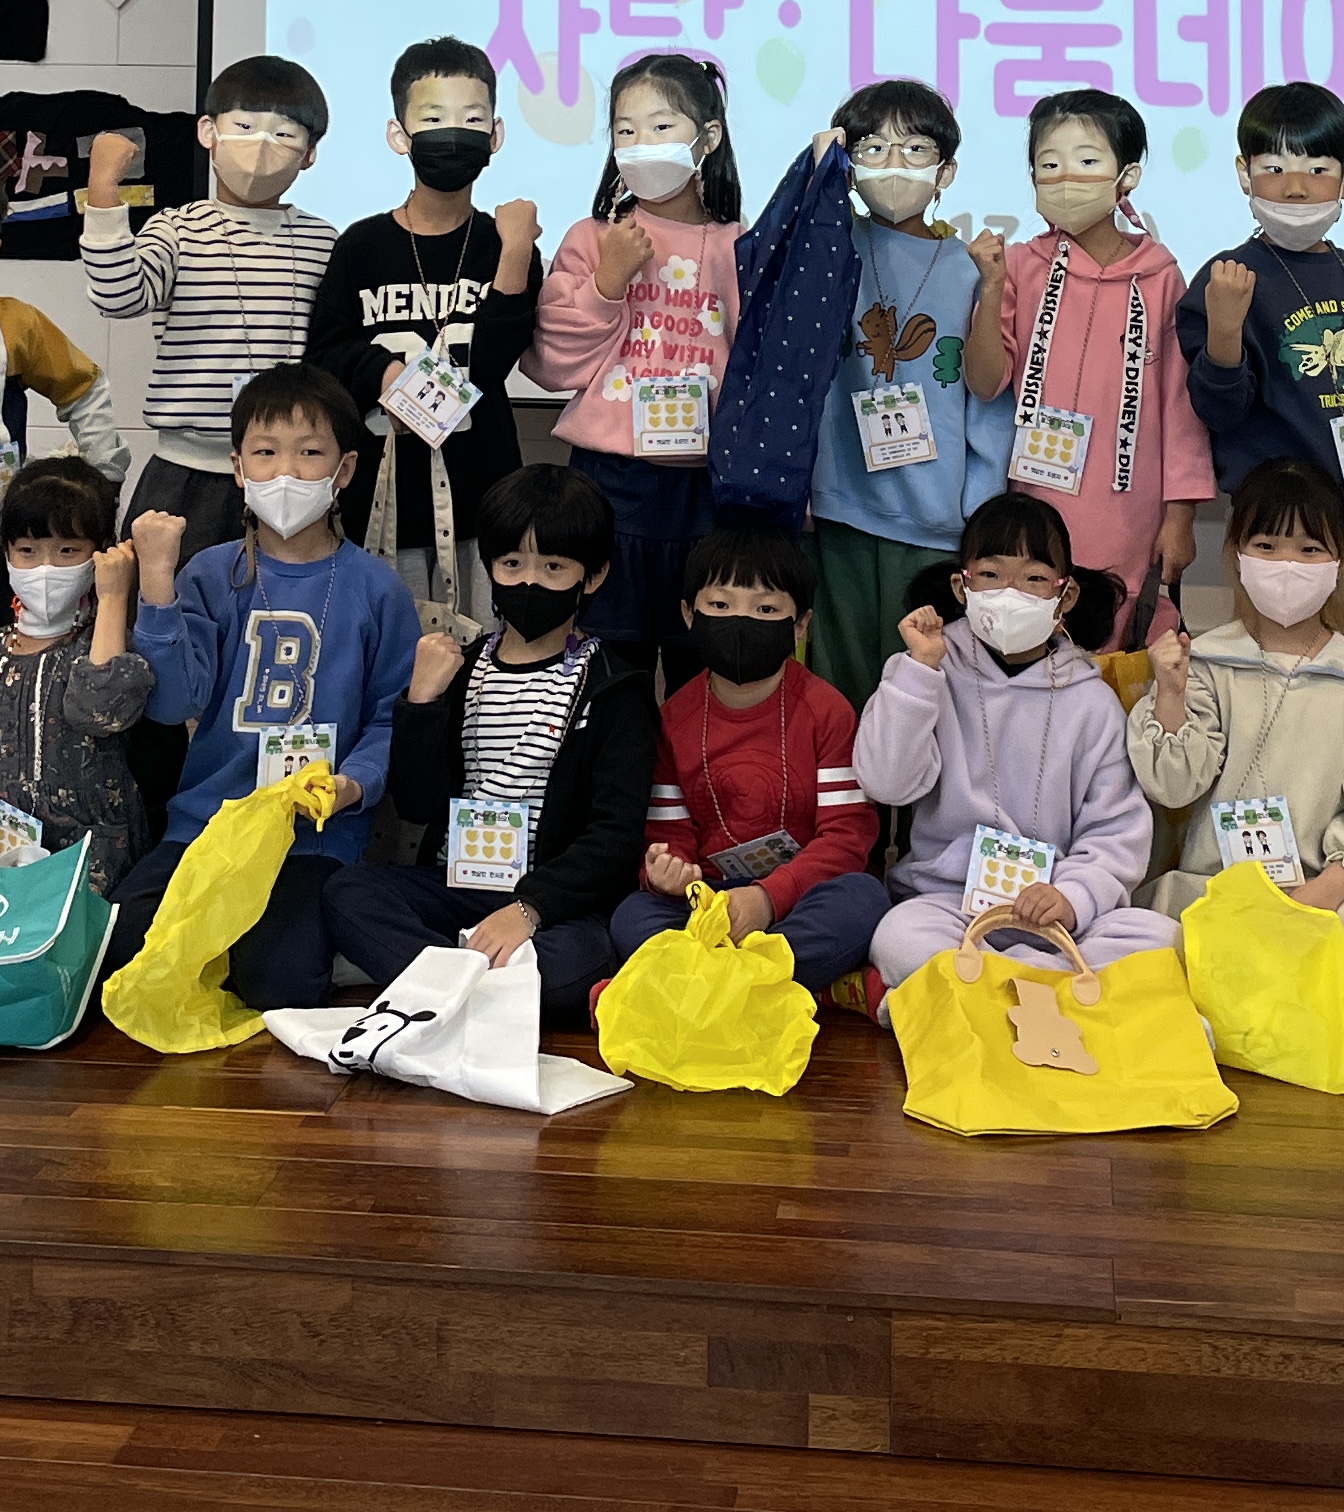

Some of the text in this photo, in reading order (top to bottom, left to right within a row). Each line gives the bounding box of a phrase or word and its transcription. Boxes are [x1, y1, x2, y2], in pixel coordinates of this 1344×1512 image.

[665, 287, 719, 312] HAVE
[1284, 305, 1315, 331] COME
[1315, 299, 1339, 315] AND
[650, 310, 704, 337] GOOD
[1022, 260, 1068, 409] DISNEY DISNEY
[619, 339, 714, 366] DAY WITH
[1120, 366, 1140, 433] DISNEY
[232, 609, 322, 732] B
